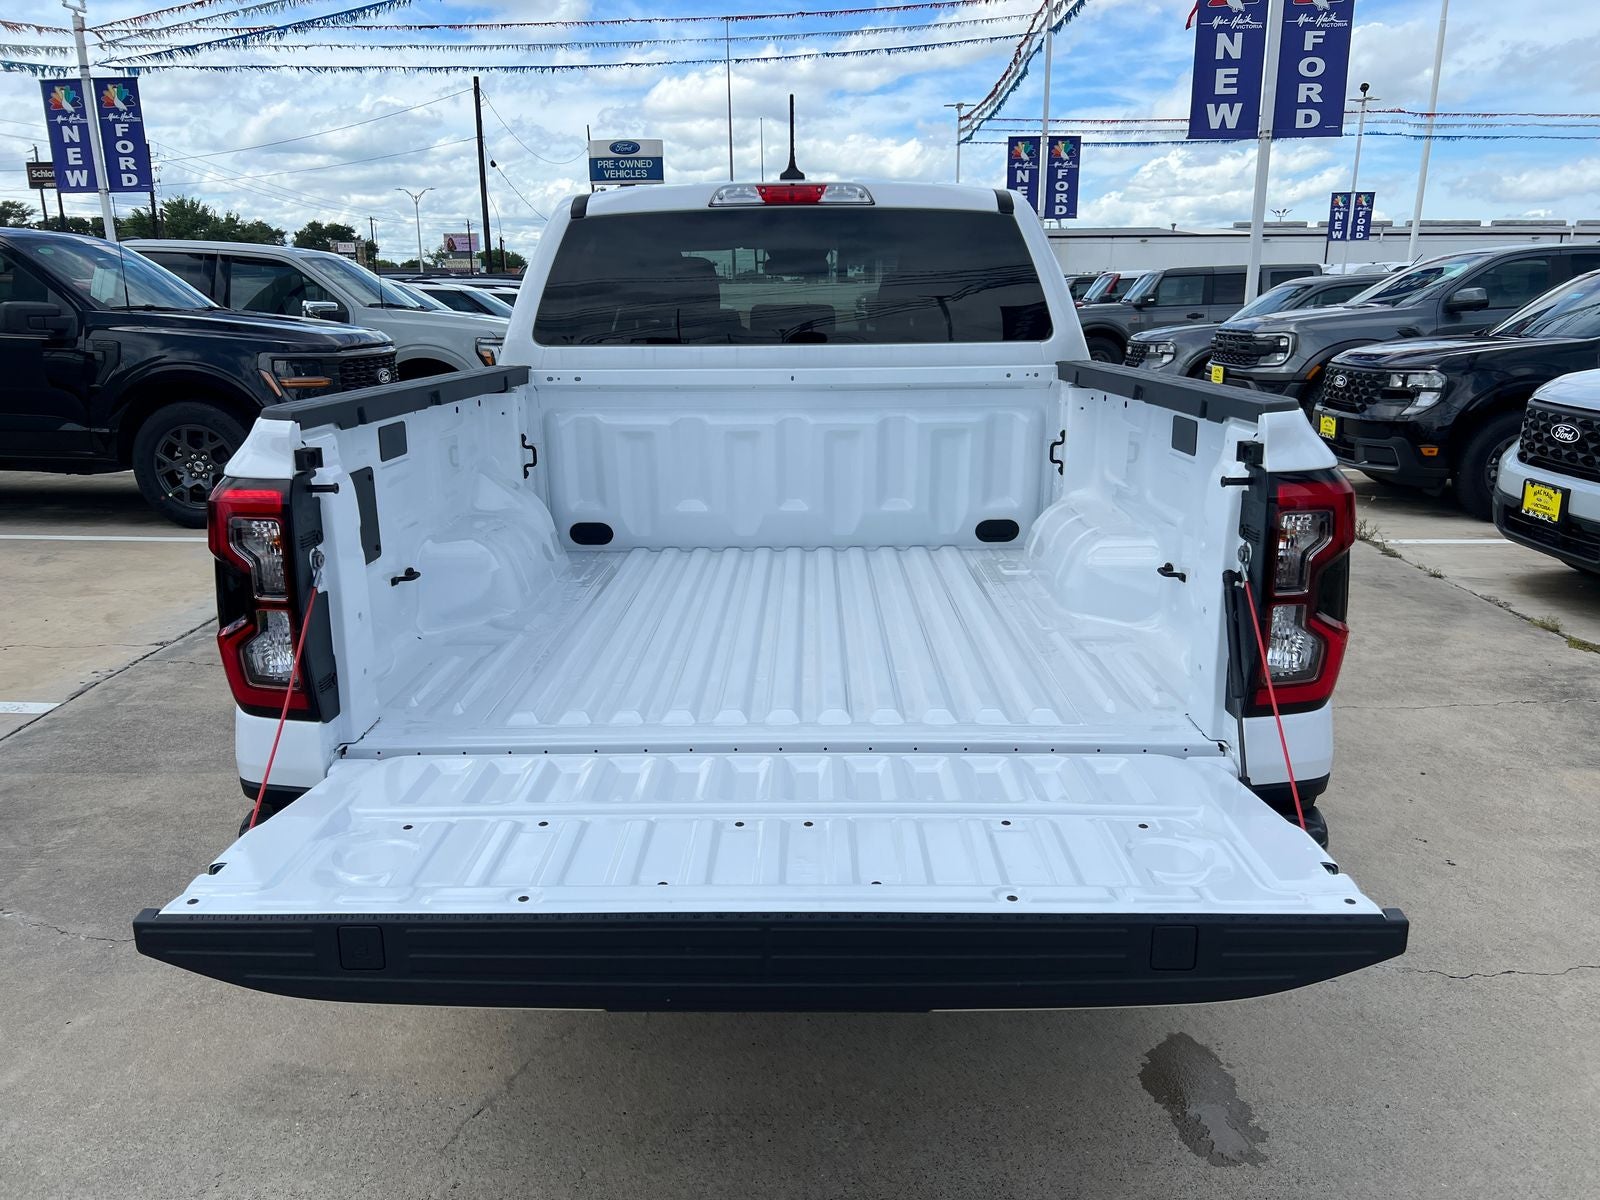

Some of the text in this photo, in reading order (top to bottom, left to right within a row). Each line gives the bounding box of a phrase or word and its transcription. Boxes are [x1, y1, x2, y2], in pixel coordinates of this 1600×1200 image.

[1212, 13, 1253, 29] Mac Haik
[1297, 12, 1338, 27] Mac Haik
[1206, 32, 1243, 129] NEW
[1294, 30, 1326, 129] FORD
[61, 125, 88, 187] NEW
[114, 123, 139, 187] FORD
[597, 160, 653, 168] PRE-OWNED
[604, 169, 648, 178] VEHICLES
[1054, 169, 1069, 215] FORD
[1332, 211, 1343, 239] NEW
[1355, 210, 1366, 239] FORD
